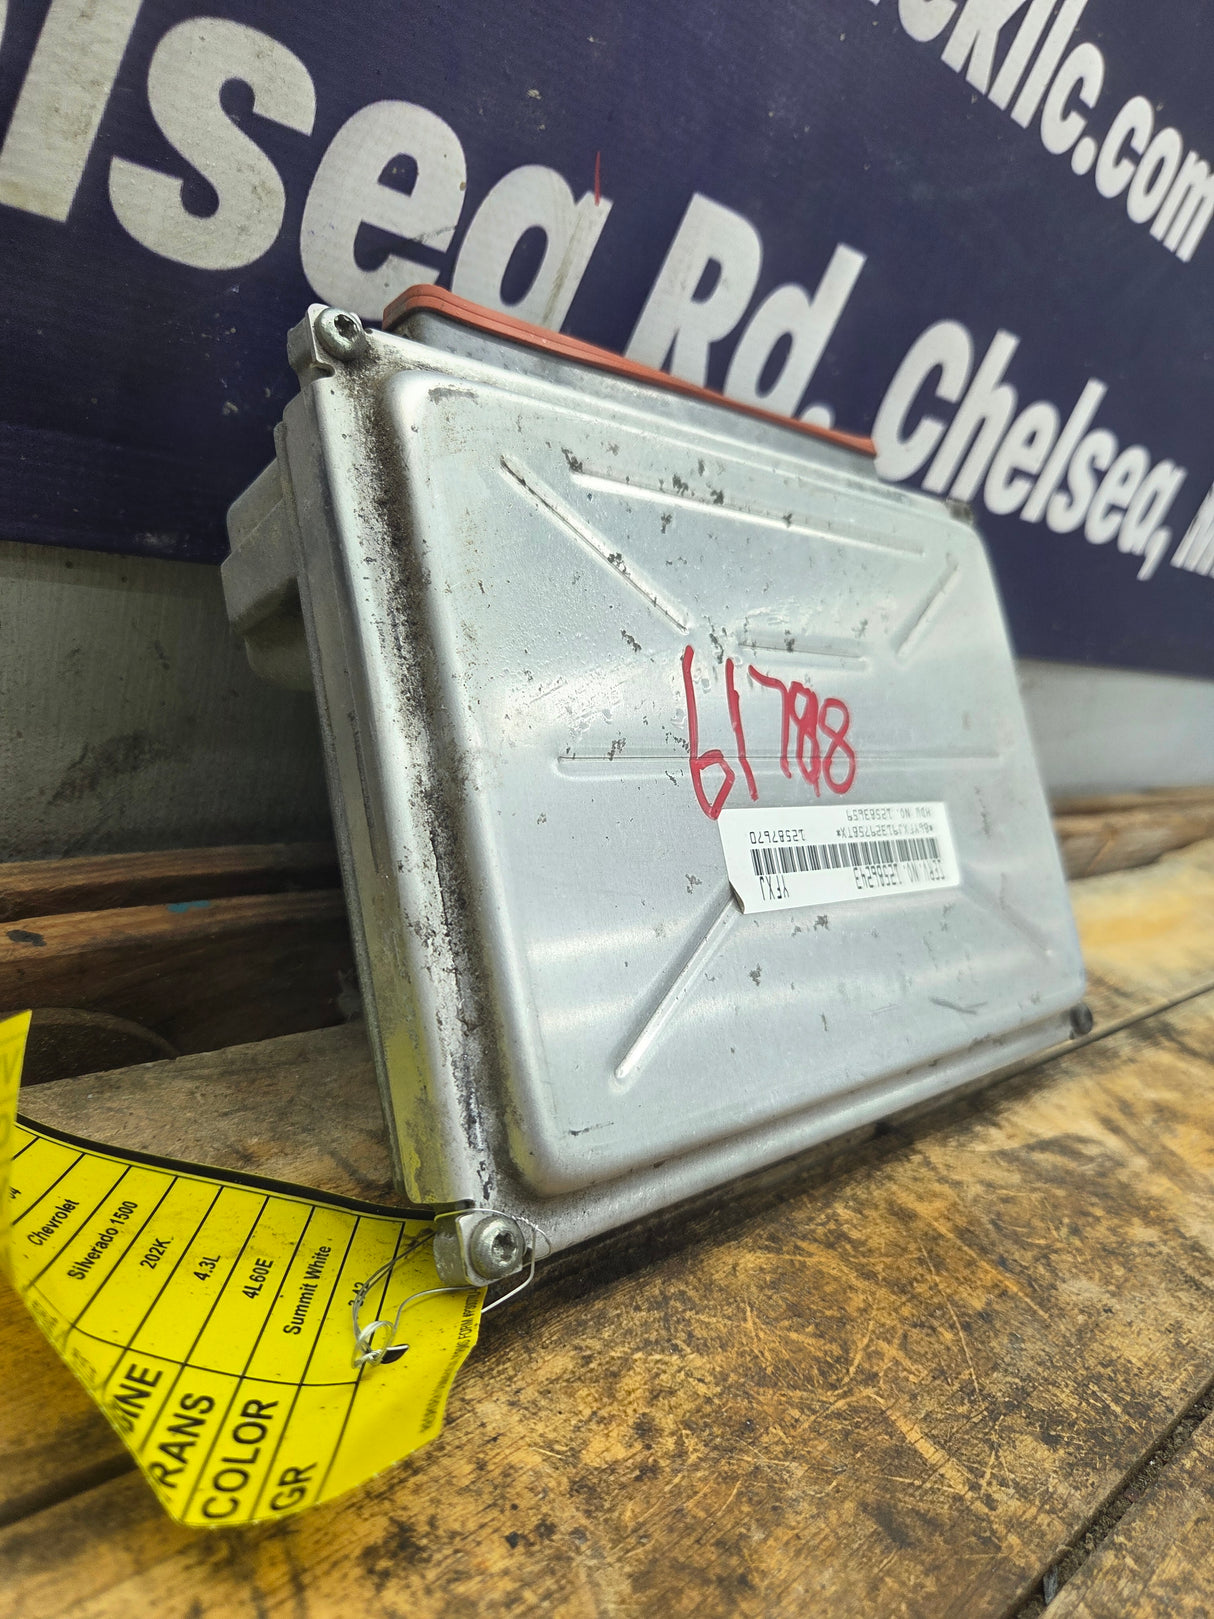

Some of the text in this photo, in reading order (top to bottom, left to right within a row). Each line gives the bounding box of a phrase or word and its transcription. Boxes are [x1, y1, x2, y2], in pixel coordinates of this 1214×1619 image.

[870, 0, 1214, 263] kllc.com
[0, 0, 613, 333] lsea
[872, 319, 1187, 581] Chelsea,
[750, 829, 806, 845] 12587670
[759, 876, 790, 901] YFXJ
[27, 1198, 80, 1247] Chevrolet
[66, 1200, 139, 1281] Silverado 1500
[140, 1238, 171, 1271] 202K
[194, 1254, 222, 1282] 4.3L
[241, 1257, 275, 1299] 4L60E
[282, 1245, 333, 1335] Summit White
[148, 1391, 216, 1489] RANS
[201, 1398, 279, 1520] COLOR
[270, 1462, 317, 1513] GR
